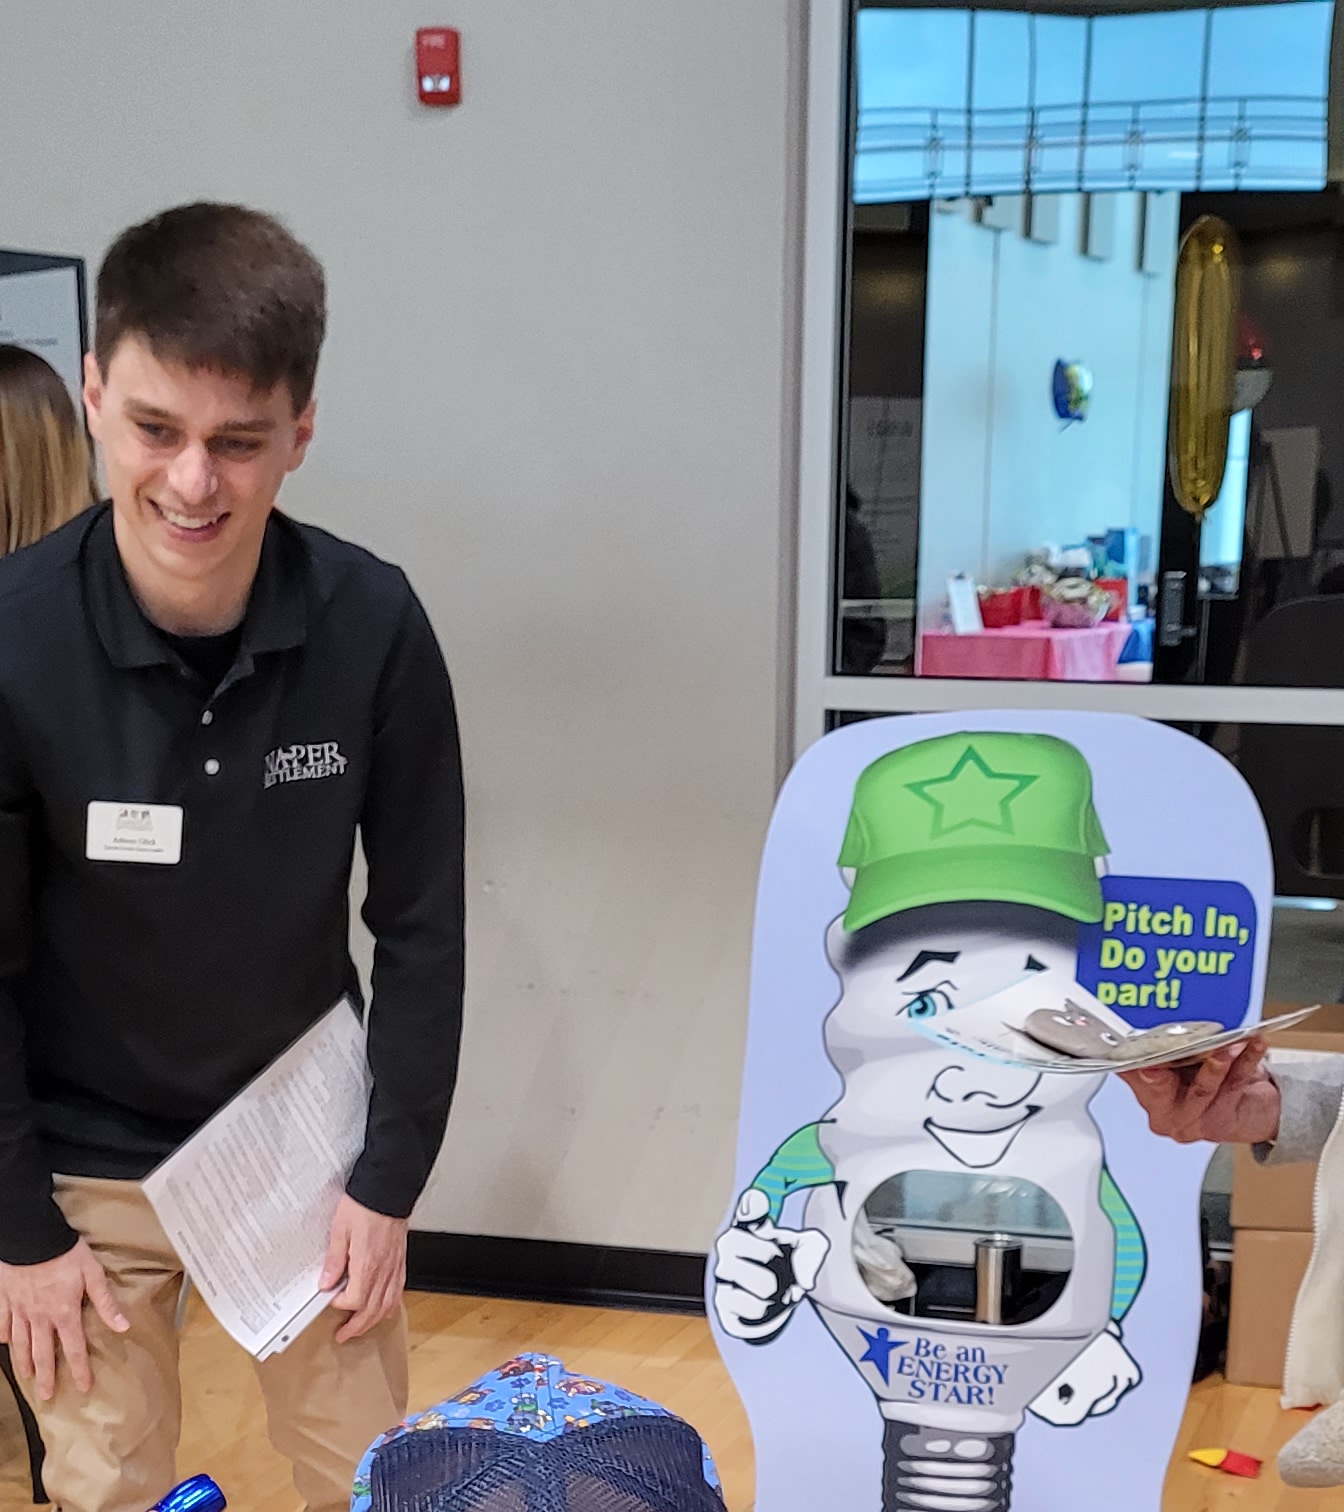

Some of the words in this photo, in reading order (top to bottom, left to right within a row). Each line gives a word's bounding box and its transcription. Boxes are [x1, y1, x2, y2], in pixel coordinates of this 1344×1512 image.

[1102, 902, 1194, 936] Pitch
[1204, 906, 1250, 945] In,
[1099, 938, 1146, 970] Do
[1154, 948, 1236, 979] your
[1097, 978, 1182, 1009] part!
[914, 1337, 948, 1360] Be
[956, 1345, 986, 1363] an
[897, 1355, 1009, 1385] ENERGY
[907, 1378, 995, 1406] STAR!
